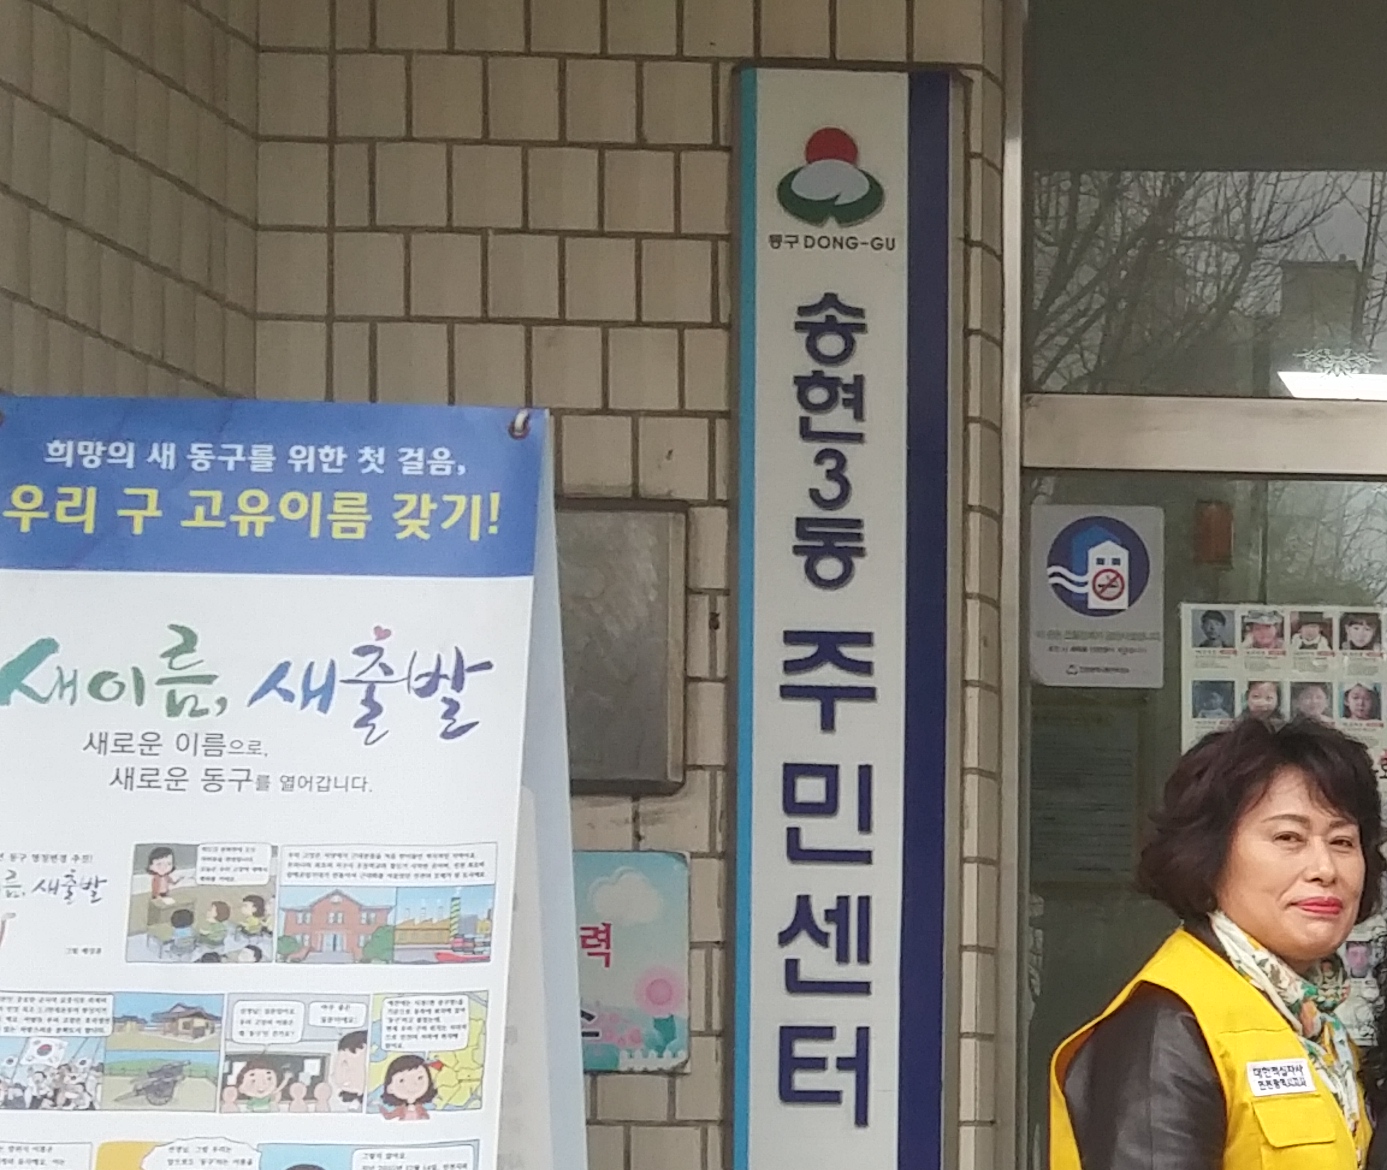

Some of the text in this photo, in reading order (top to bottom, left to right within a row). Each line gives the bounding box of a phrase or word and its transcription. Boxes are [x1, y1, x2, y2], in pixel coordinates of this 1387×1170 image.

[769, 234, 896, 251] 동구 DONG-GU
[44, 439, 467, 477] 희망의 새 동구를 위한 첫 걸음,
[791, 293, 868, 590] 송현3동
[3, 484, 501, 541] 우리 구 고유이름 갖기!
[247, 625, 494, 746] 새출발
[82, 731, 269, 759] 새로운 이름으로,
[109, 766, 374, 794] 새로운 동구를 열어갑니다.
[777, 630, 878, 1129] 주민센터
